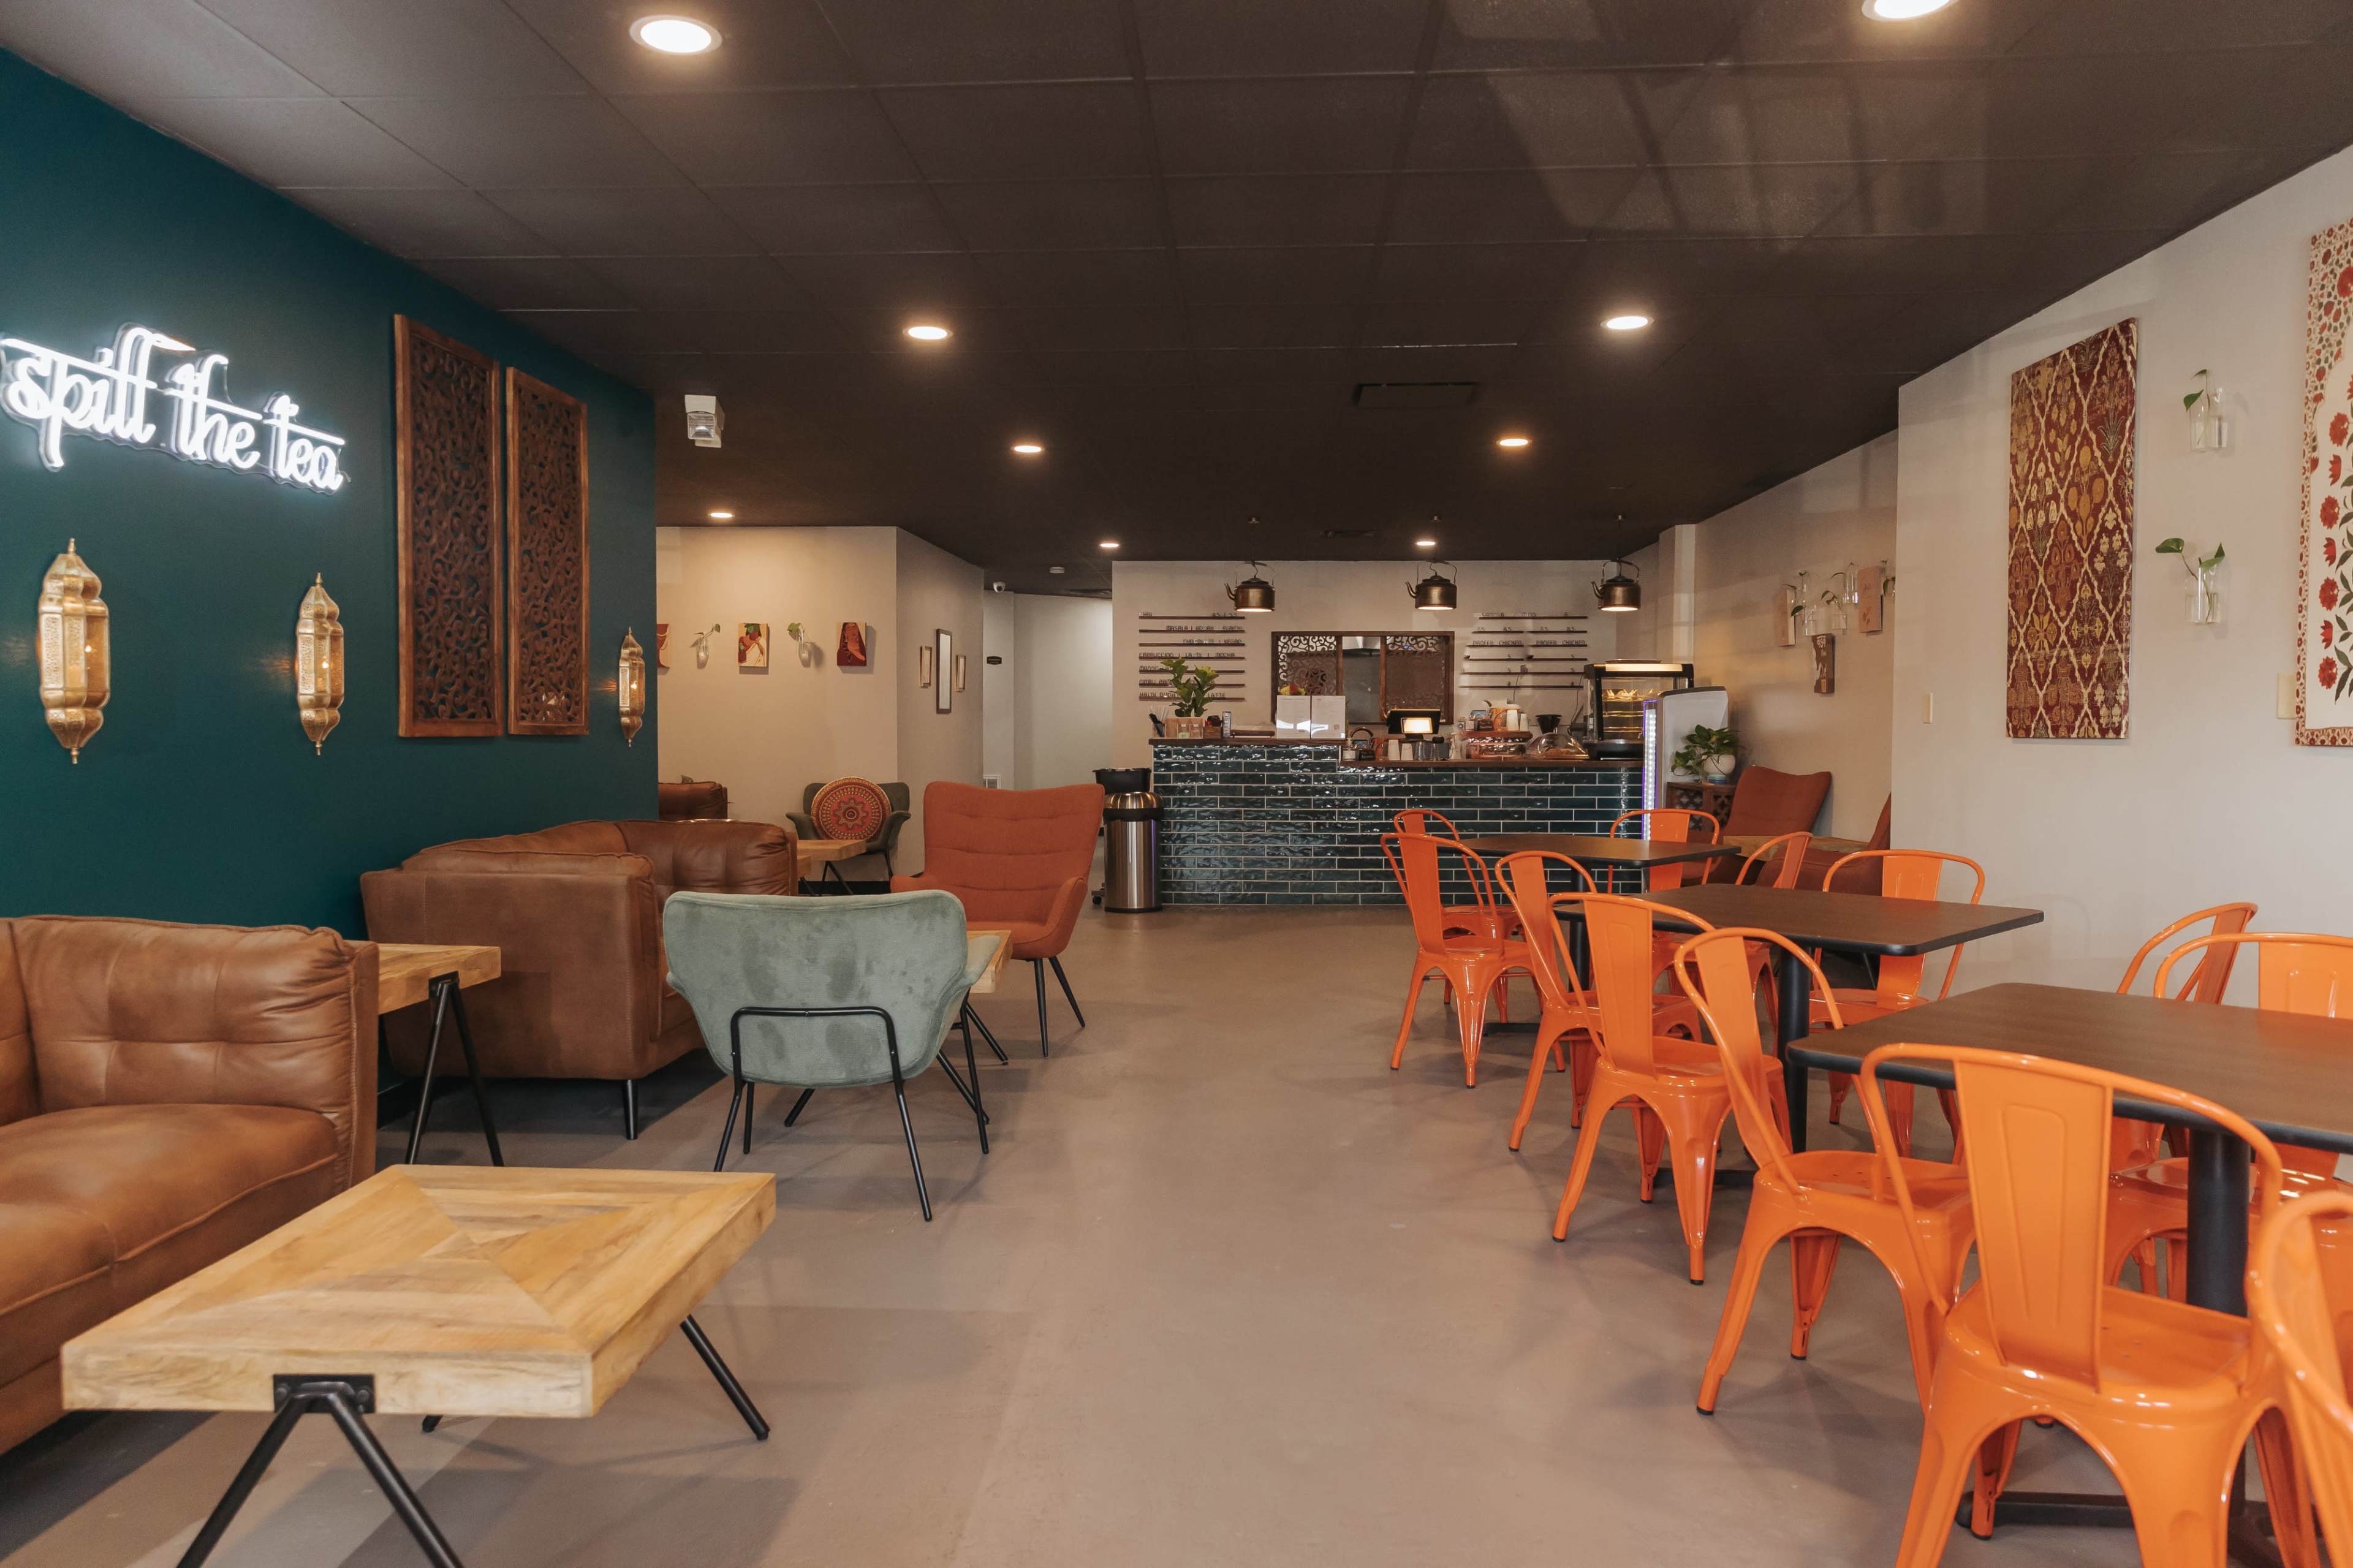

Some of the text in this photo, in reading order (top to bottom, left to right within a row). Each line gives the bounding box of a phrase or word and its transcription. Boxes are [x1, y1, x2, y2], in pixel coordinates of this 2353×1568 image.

[0, 326, 345, 490] spill the tea
